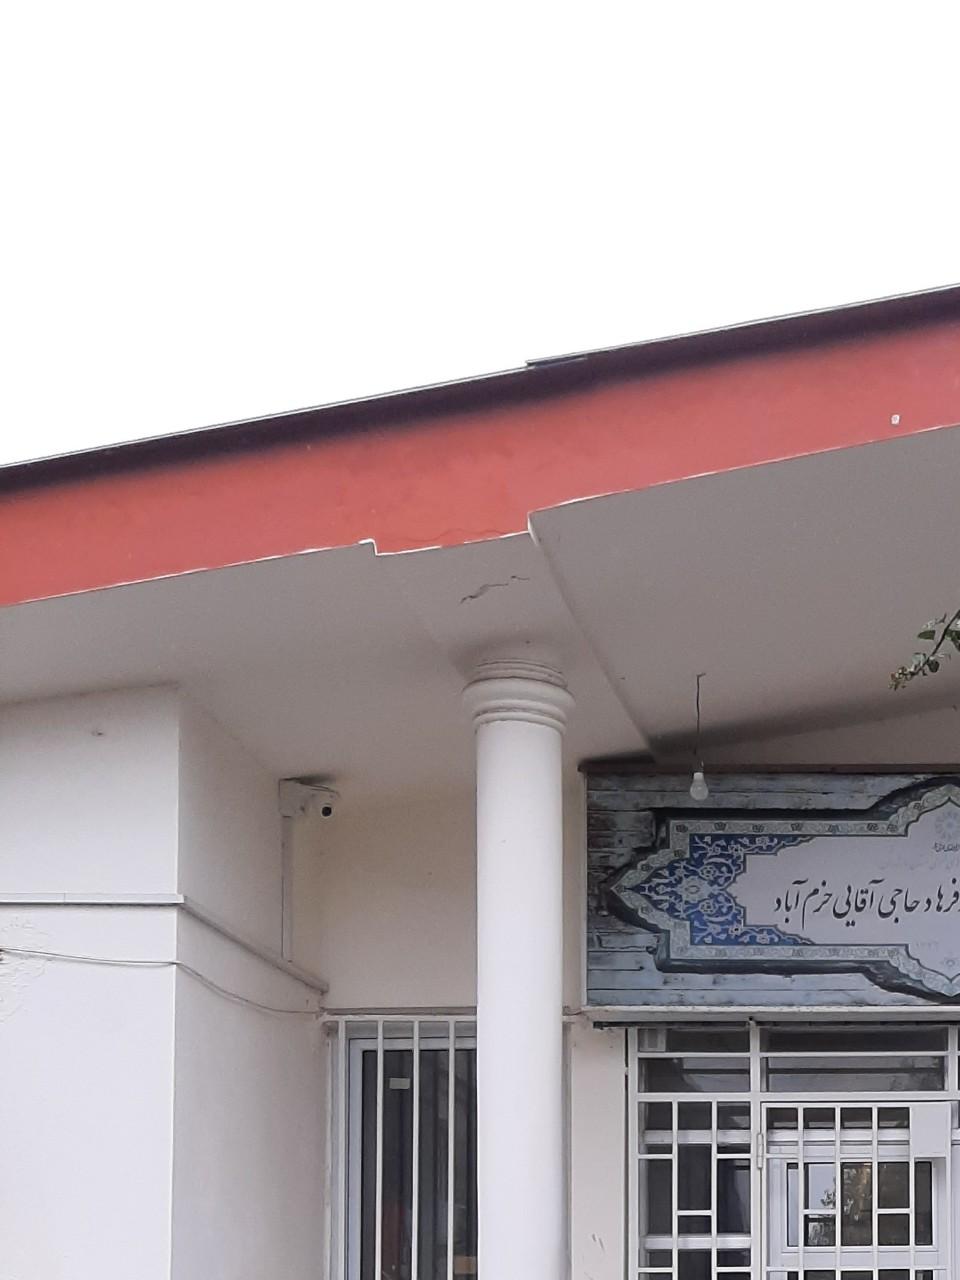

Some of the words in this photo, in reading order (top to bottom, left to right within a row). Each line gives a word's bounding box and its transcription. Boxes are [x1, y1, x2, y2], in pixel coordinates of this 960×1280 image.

[774, 878, 809, 924] آباد
[801, 879, 833, 931] خرم
[832, 878, 885, 928] آقایی
[877, 887, 921, 924] حاجی
[923, 877, 960, 913] فرهاد
